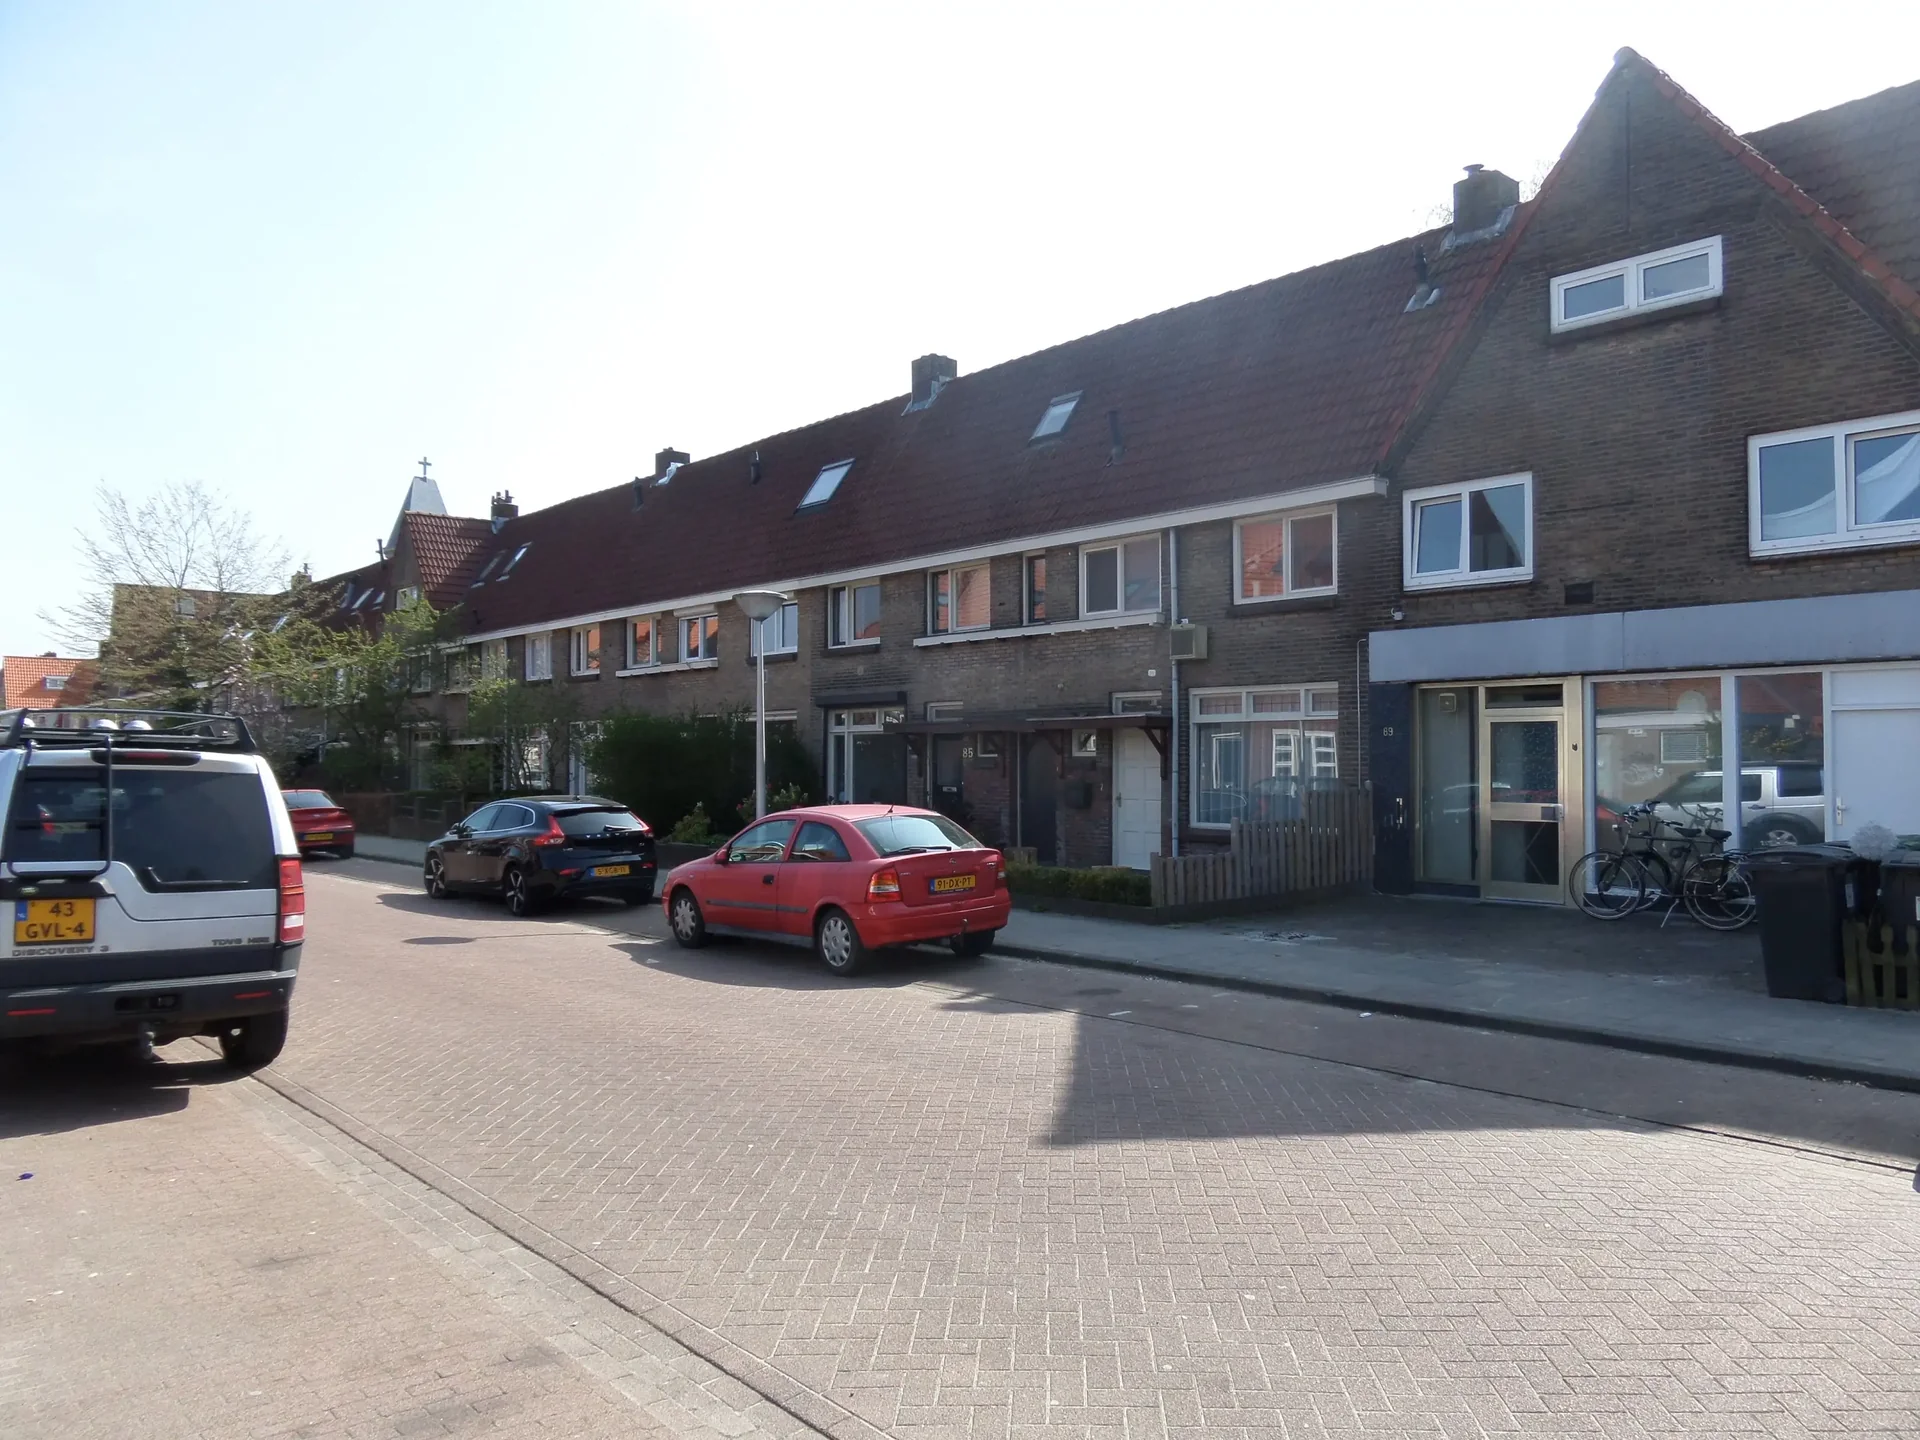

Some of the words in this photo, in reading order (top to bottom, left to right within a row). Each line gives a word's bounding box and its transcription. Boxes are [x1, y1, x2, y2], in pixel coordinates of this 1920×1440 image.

[962, 747, 974, 758] 85
[937, 876, 972, 889] 91-DX-PT
[49, 902, 75, 918] 43
[25, 921, 87, 939] GVL-4
[12, 945, 95, 957] DISCOVERY
[100, 945, 110, 953] 3
